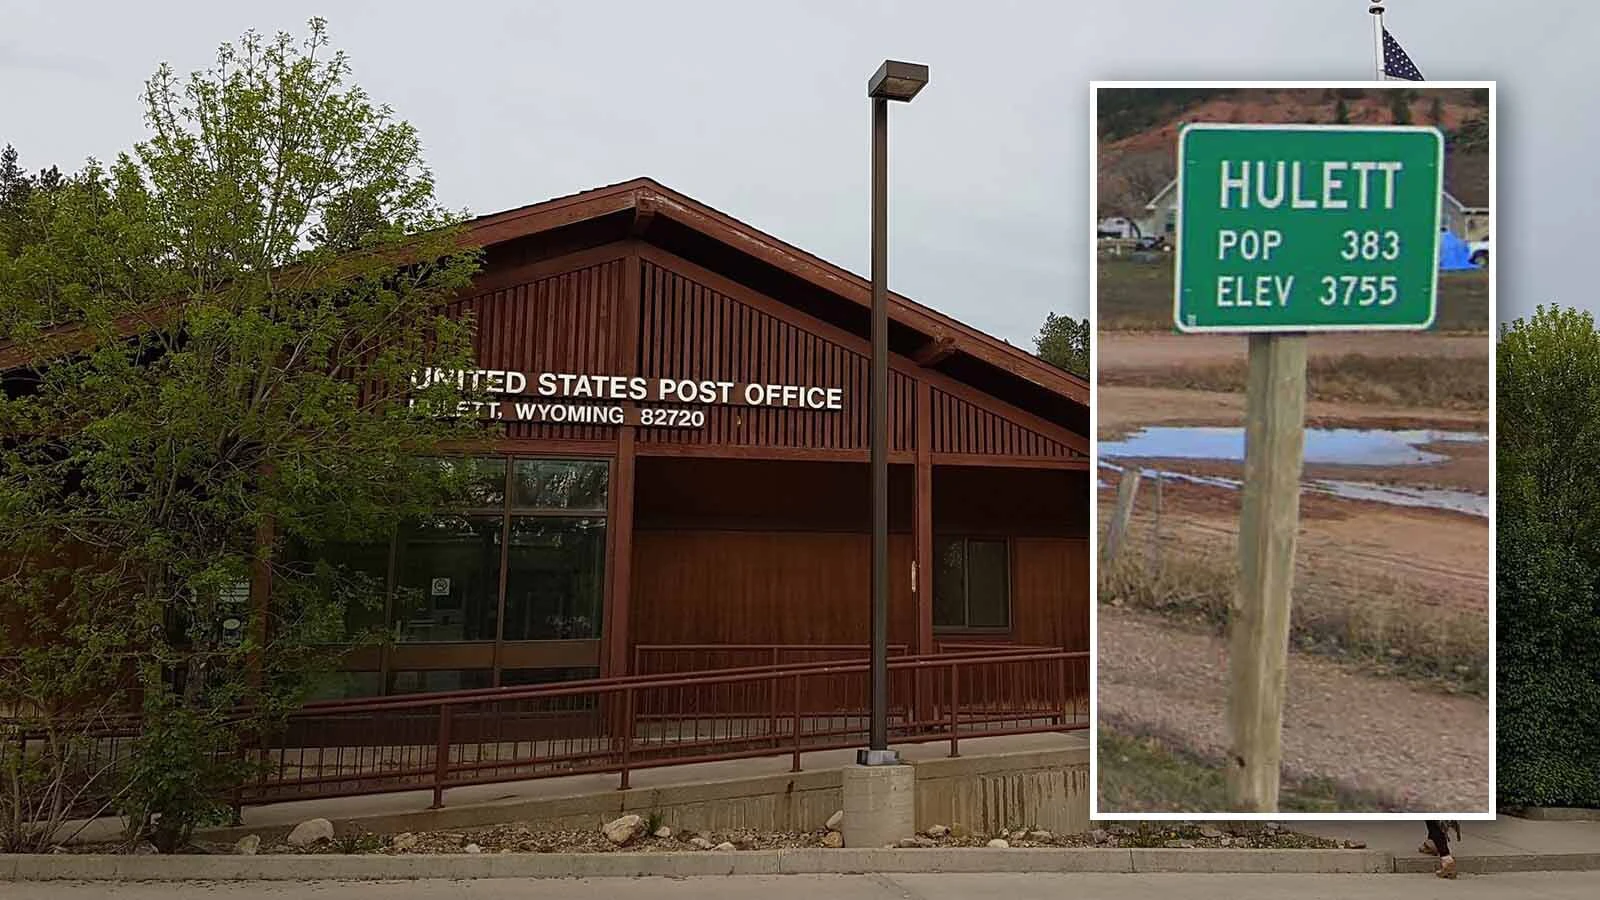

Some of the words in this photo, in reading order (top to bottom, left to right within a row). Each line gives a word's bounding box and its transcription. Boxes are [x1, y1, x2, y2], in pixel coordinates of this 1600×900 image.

[1220, 160, 1402, 209] HULETT
[1218, 230, 1282, 260] POP
[1341, 230, 1400, 260] 383
[1217, 275, 1294, 306] ELEV
[1319, 275, 1398, 306] 3755
[410, 367, 526, 394] UNITED
[538, 373, 647, 399] STATES
[659, 378, 734, 404] POST
[744, 383, 842, 410] OFFICE
[515, 403, 624, 424] WYOMING
[641, 408, 705, 427] 82720
